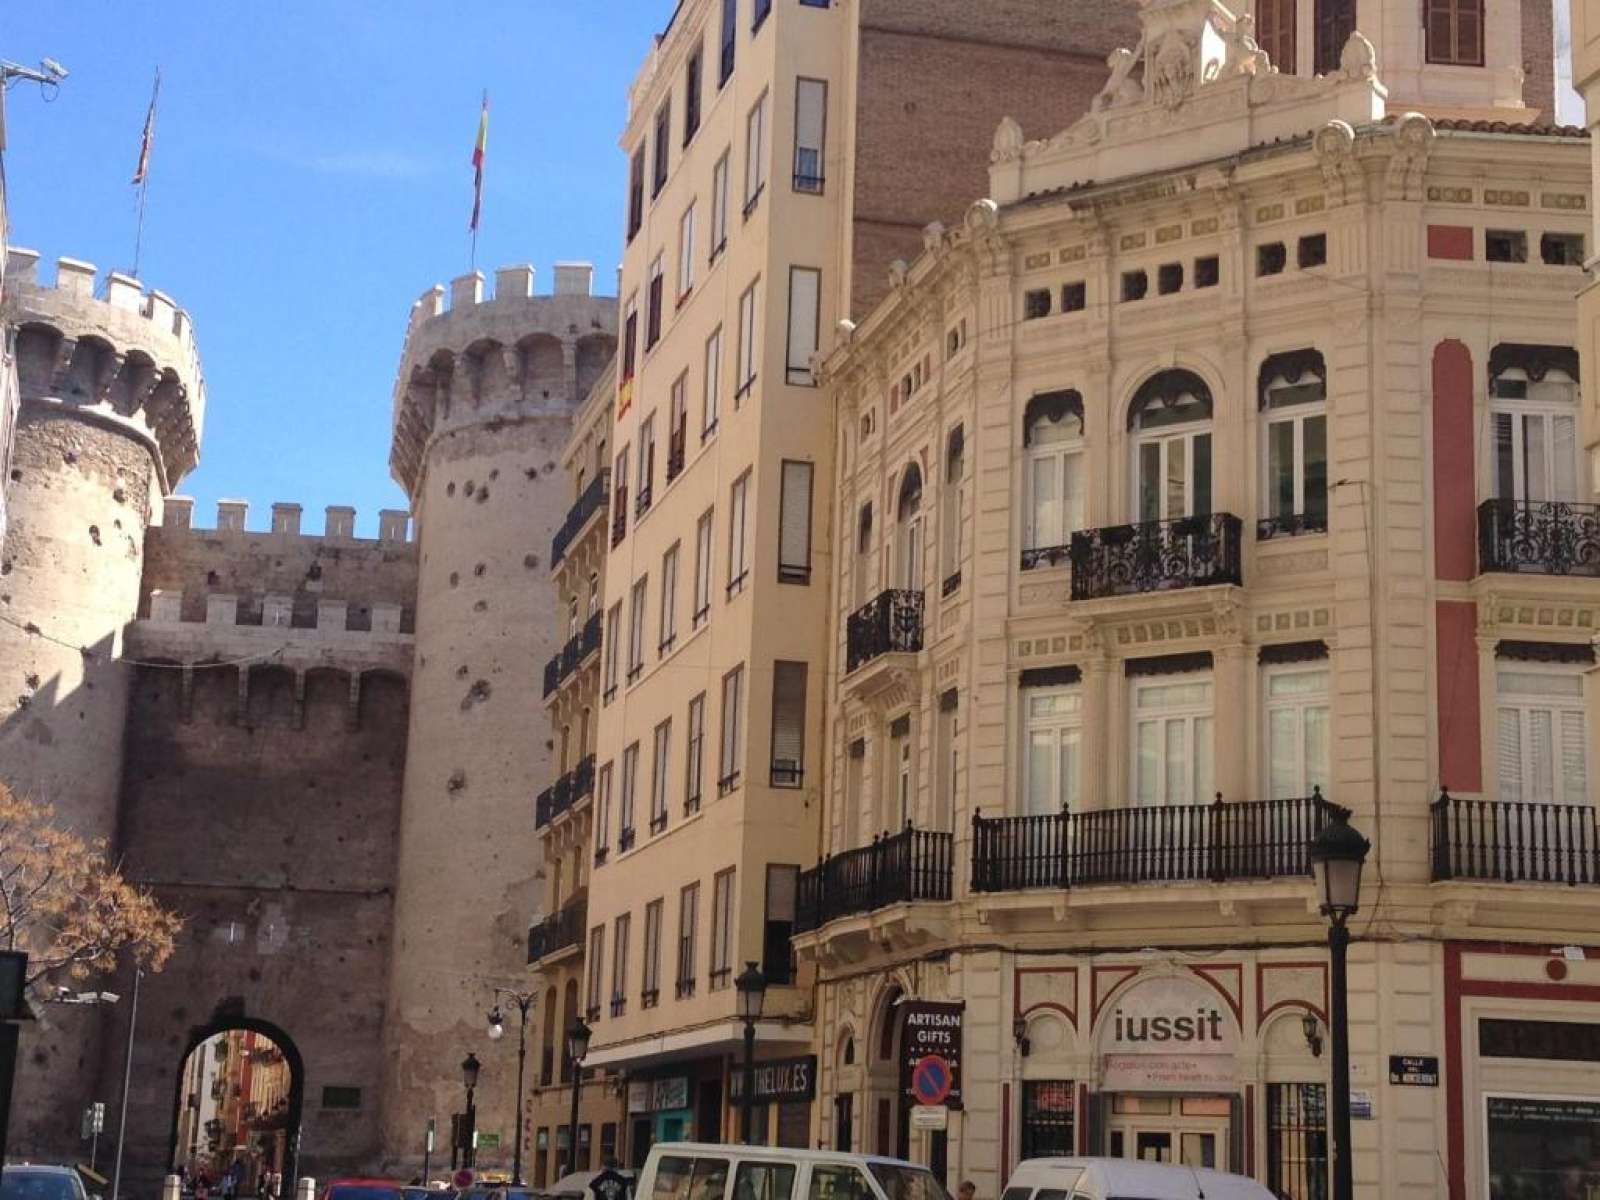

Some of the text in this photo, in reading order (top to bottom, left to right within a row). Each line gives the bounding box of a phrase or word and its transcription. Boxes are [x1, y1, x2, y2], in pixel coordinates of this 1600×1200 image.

[908, 1013, 960, 1027] ARTISAN
[1115, 1008, 1222, 1041] iussit
[917, 1030, 951, 1043] GIFTS
